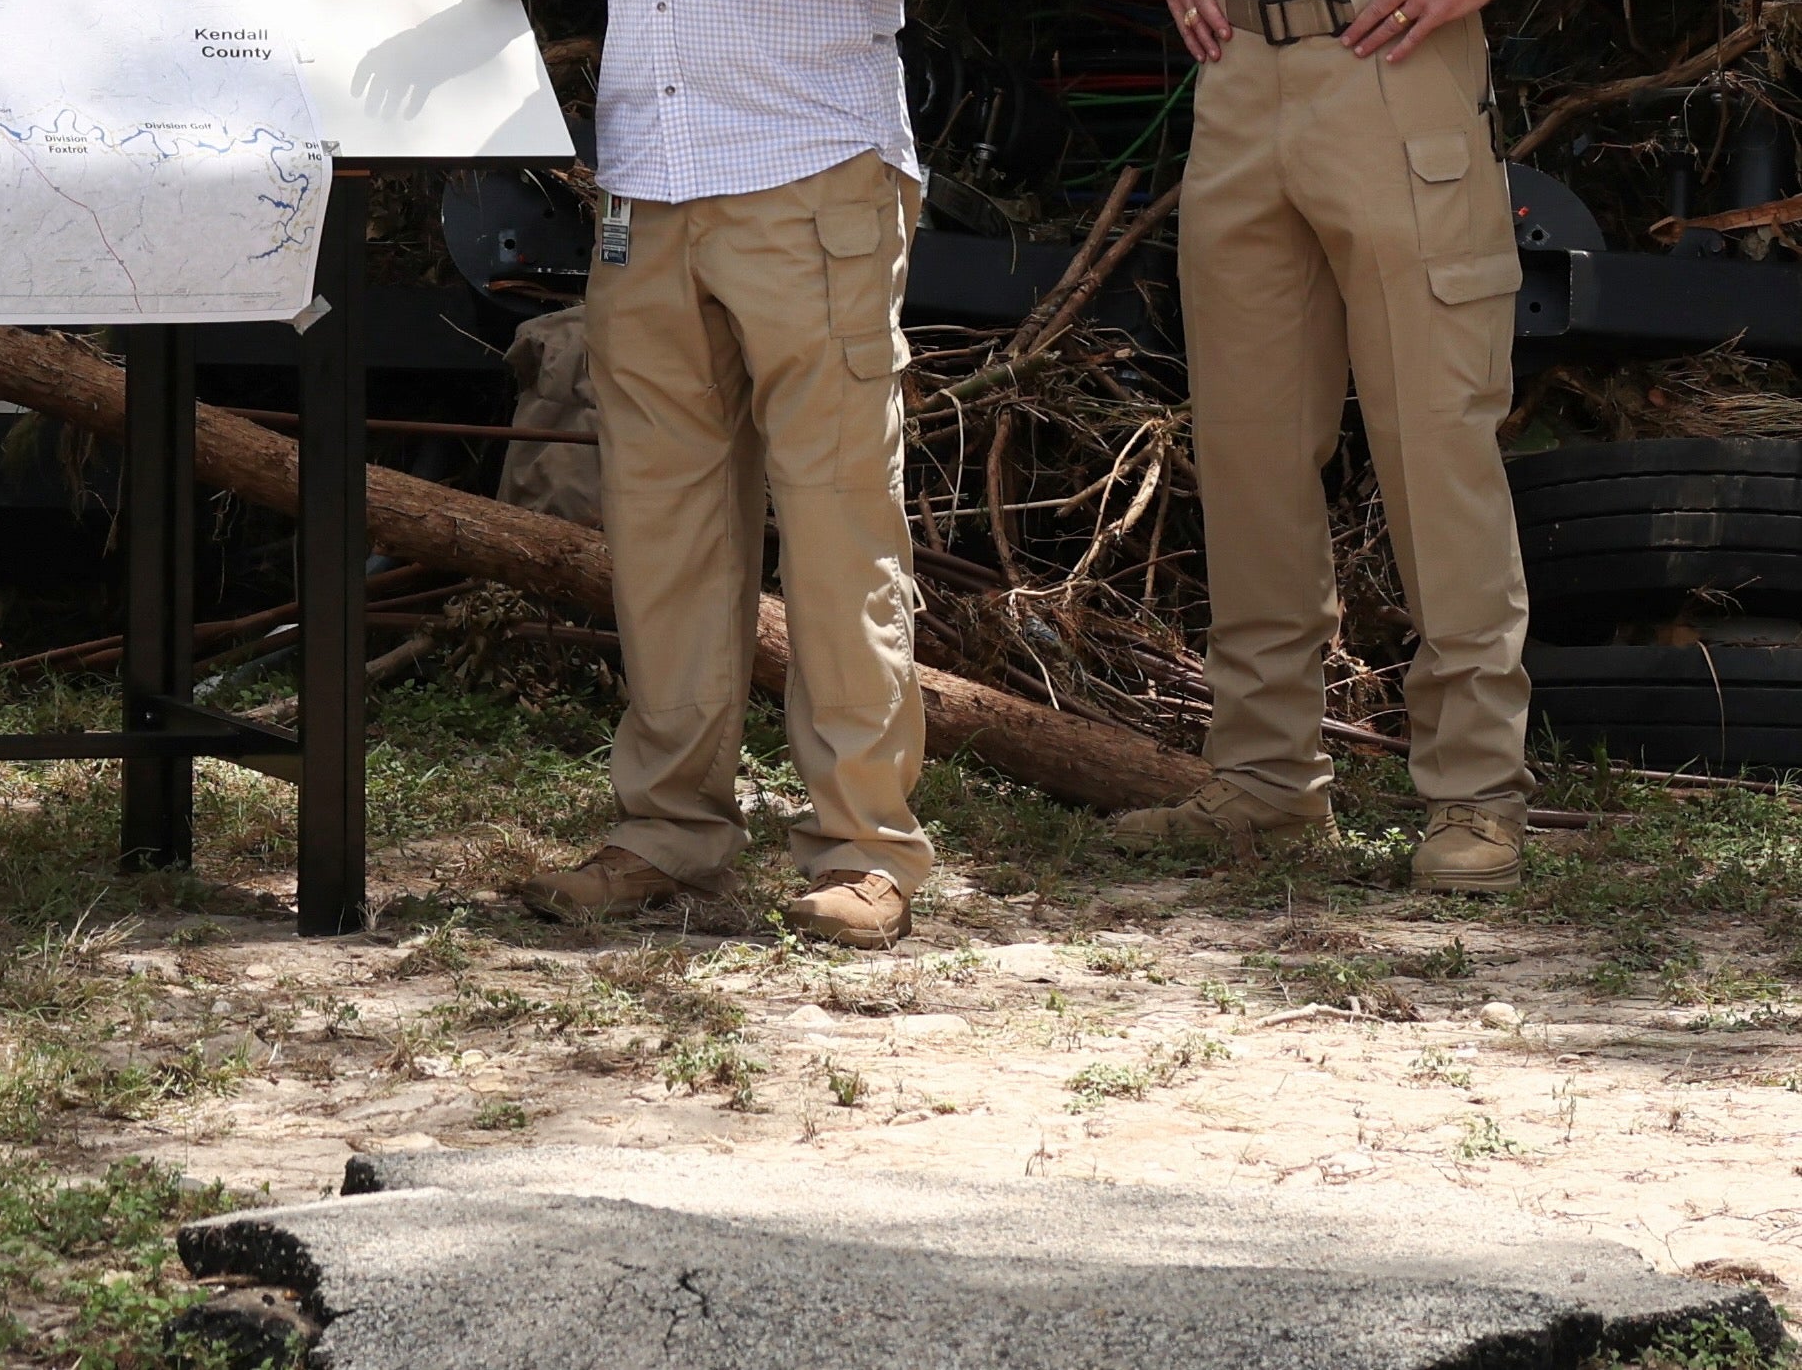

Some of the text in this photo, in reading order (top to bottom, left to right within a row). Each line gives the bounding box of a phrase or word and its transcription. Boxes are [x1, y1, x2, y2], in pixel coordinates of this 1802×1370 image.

[194, 28, 268, 40] Kendall
[201, 46, 272, 61] County
[144, 122, 212, 131] Division Golf
[44, 134, 88, 143] Division
[49, 145, 88, 154] Foxtrot
